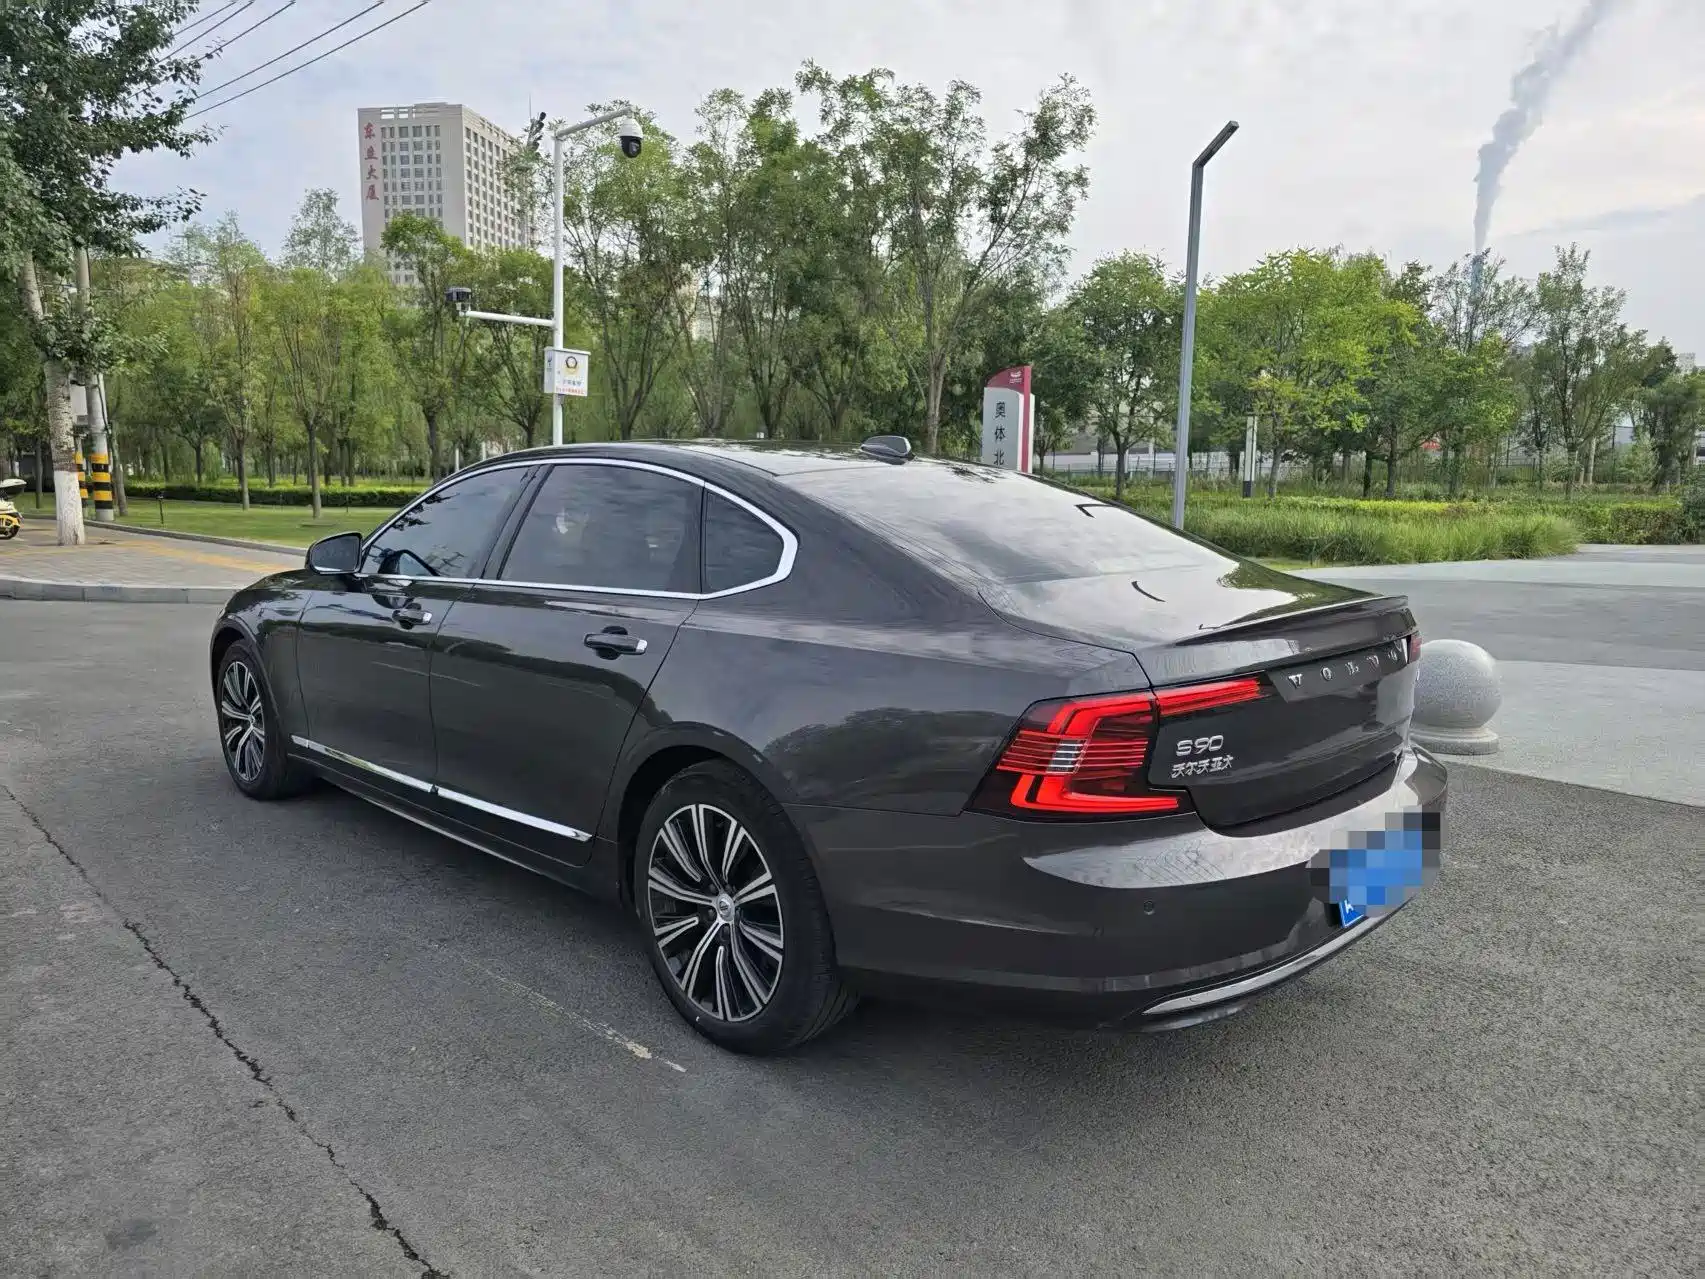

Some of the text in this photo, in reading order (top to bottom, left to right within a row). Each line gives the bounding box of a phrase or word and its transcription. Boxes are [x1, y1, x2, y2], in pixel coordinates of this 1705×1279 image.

[993, 401, 1006, 466] 奥体北
[1176, 735, 1224, 757] S90
